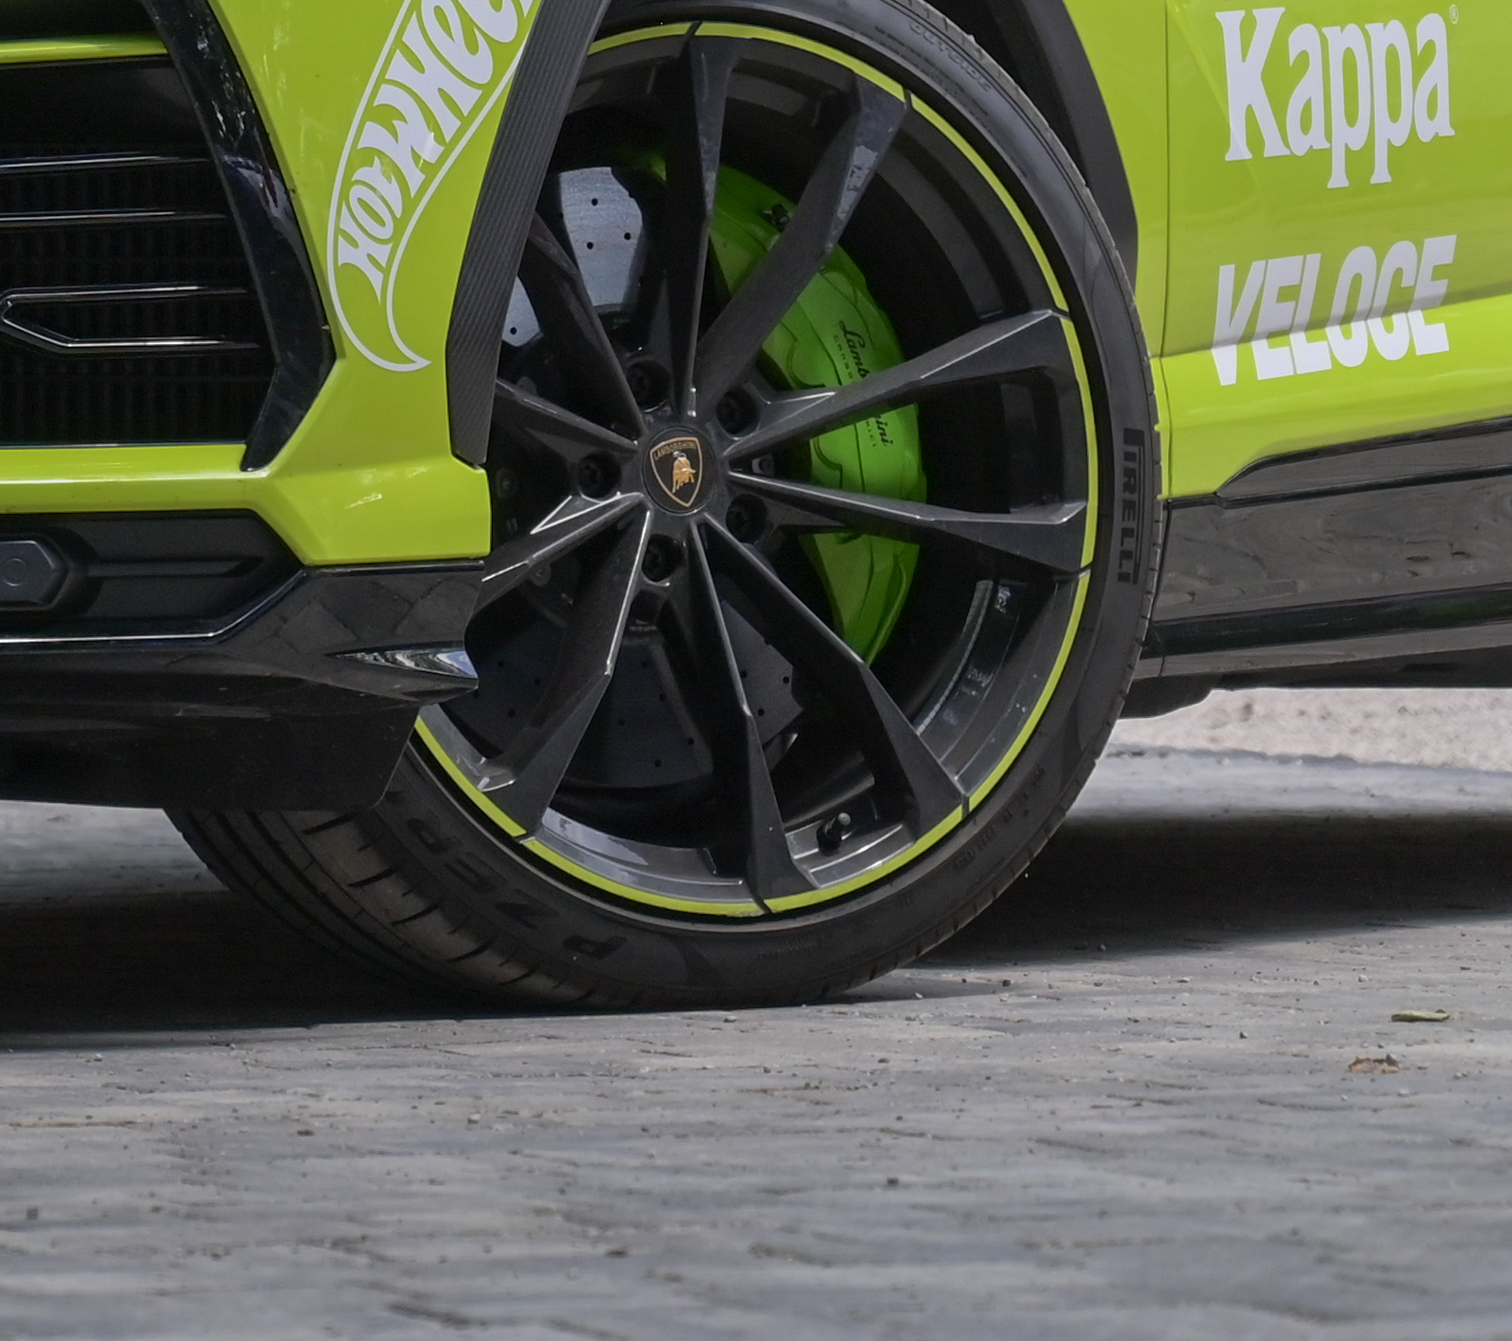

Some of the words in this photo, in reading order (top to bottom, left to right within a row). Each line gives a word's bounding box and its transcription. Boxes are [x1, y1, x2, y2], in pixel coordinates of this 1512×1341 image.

[1215, 6, 1456, 189] Kappa
[1211, 234, 1458, 387] VELOCE
[1117, 428, 1145, 585] PIRELLI
